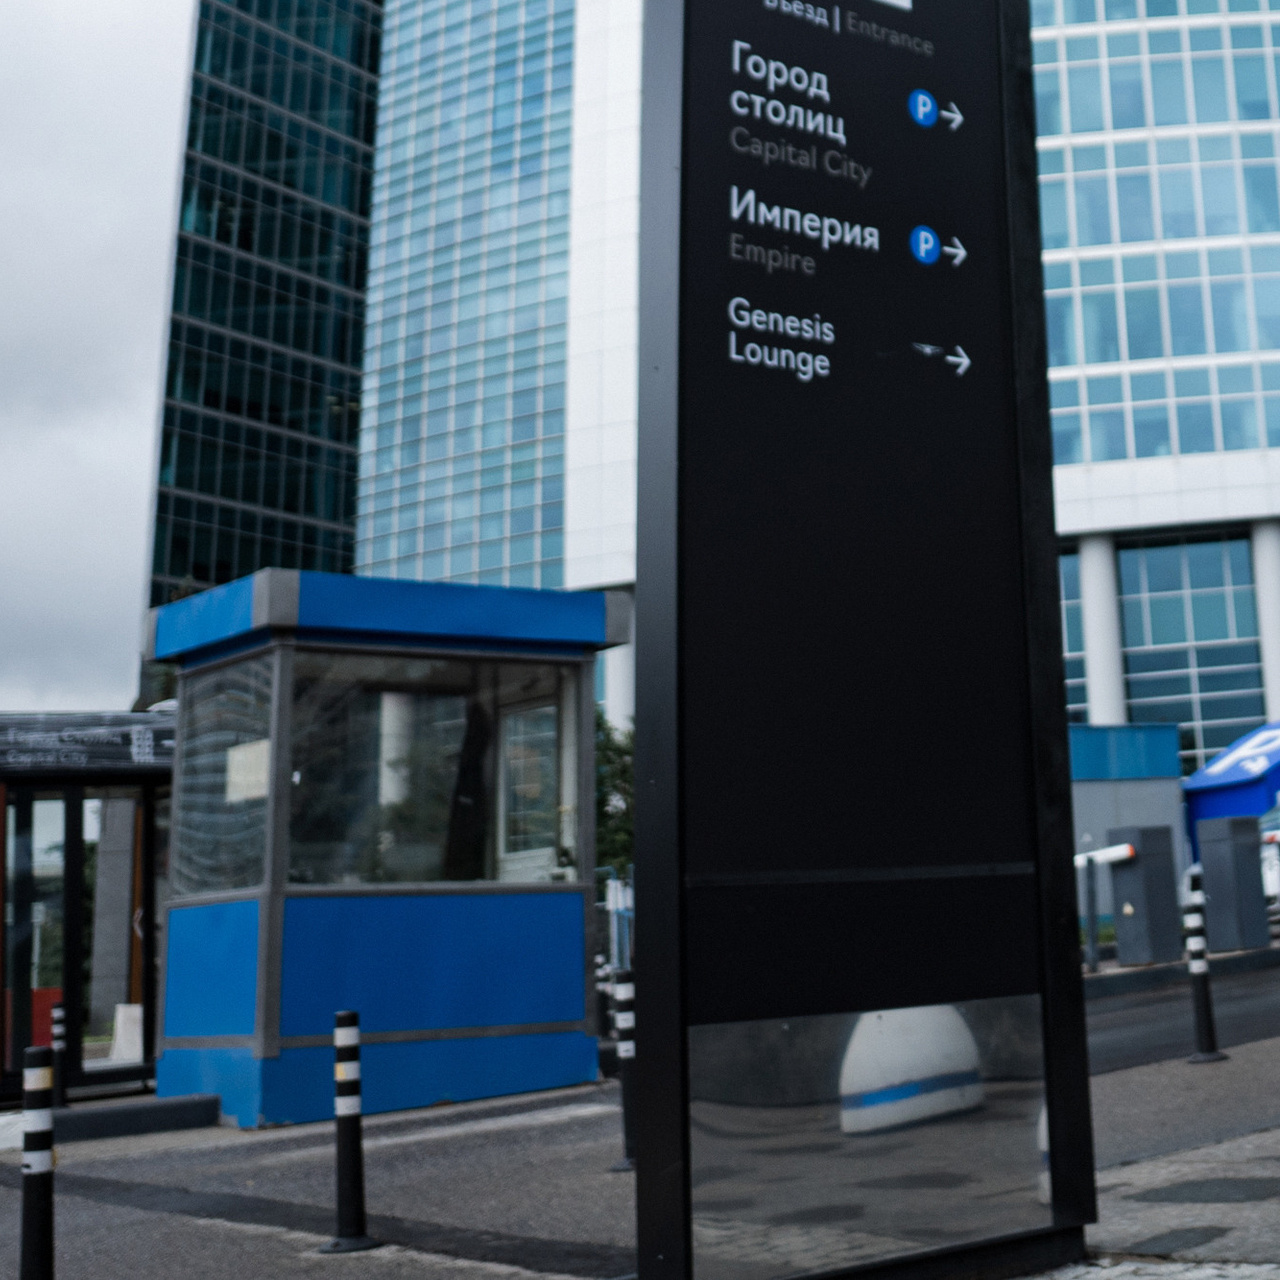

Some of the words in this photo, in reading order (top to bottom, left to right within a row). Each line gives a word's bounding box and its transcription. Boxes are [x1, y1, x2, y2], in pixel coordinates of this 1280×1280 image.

[845, 10, 935, 57] Entrance
[731, 39, 831, 103] Город
[730, 89, 847, 147] столиц
[730, 126, 817, 170] Capital
[823, 149, 873, 189] City
[730, 185, 880, 251] Империя
[730, 232, 816, 275] Empire
[728, 296, 836, 343] Genesis
[729, 330, 831, 382] Lounge
